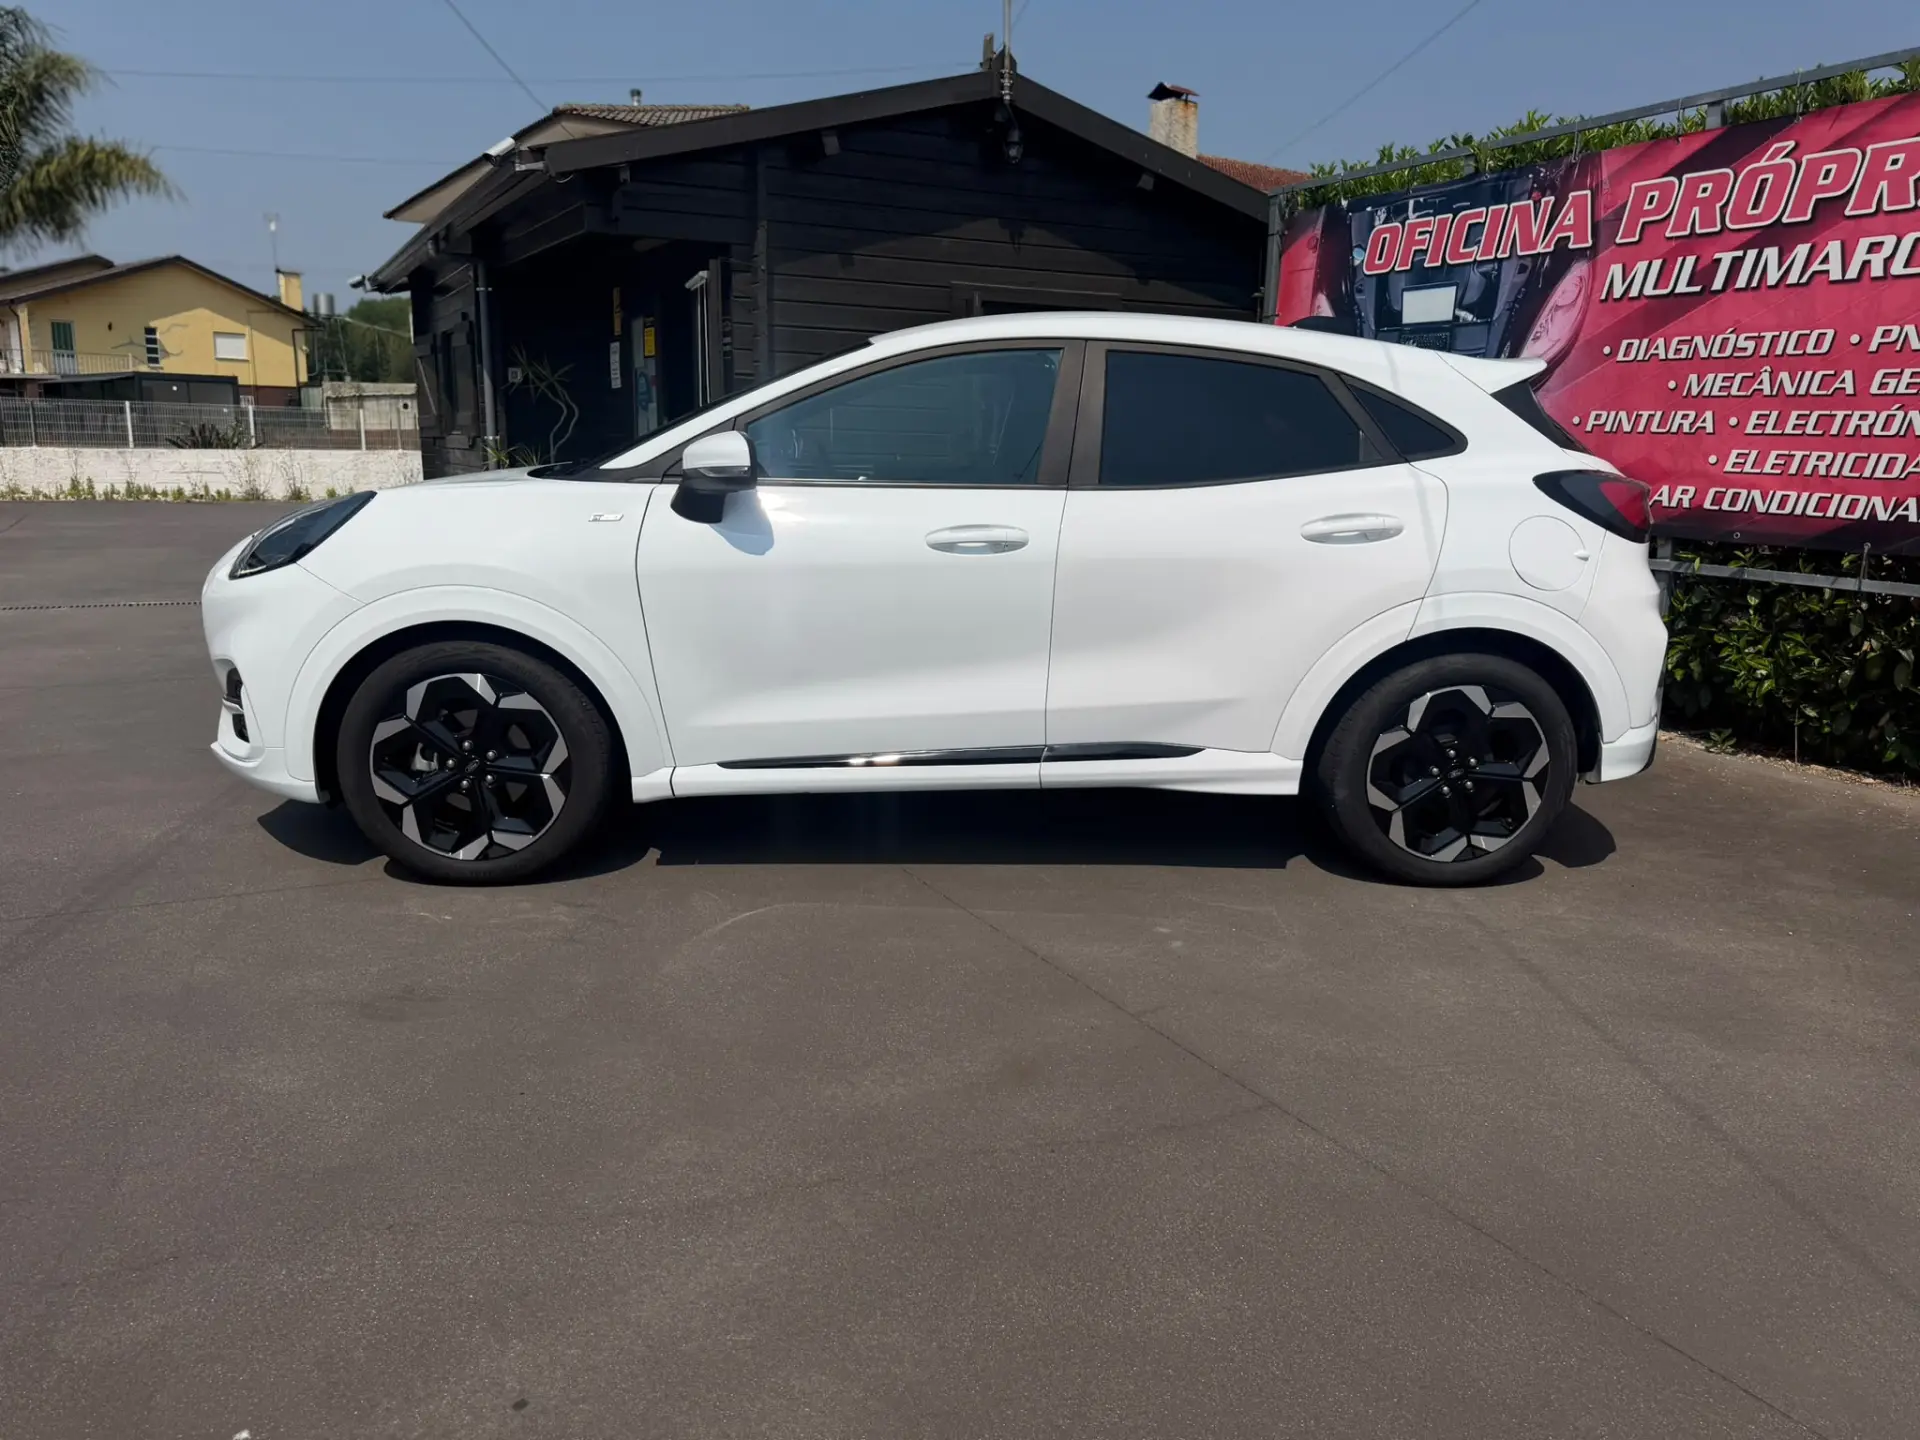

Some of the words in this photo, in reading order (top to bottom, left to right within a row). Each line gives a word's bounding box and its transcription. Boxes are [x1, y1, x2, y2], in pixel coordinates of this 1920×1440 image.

[1363, 189, 1593, 275] OFICINA
[1616, 135, 1920, 244] PRÓPR
[1600, 231, 1920, 300] MULTIMARC
[1616, 327, 1836, 362] DIAGNÓSTICO
[1682, 366, 1856, 397] MECÂNICA
[1585, 410, 1715, 434] PINTURA
[1648, 484, 1696, 509] AR
